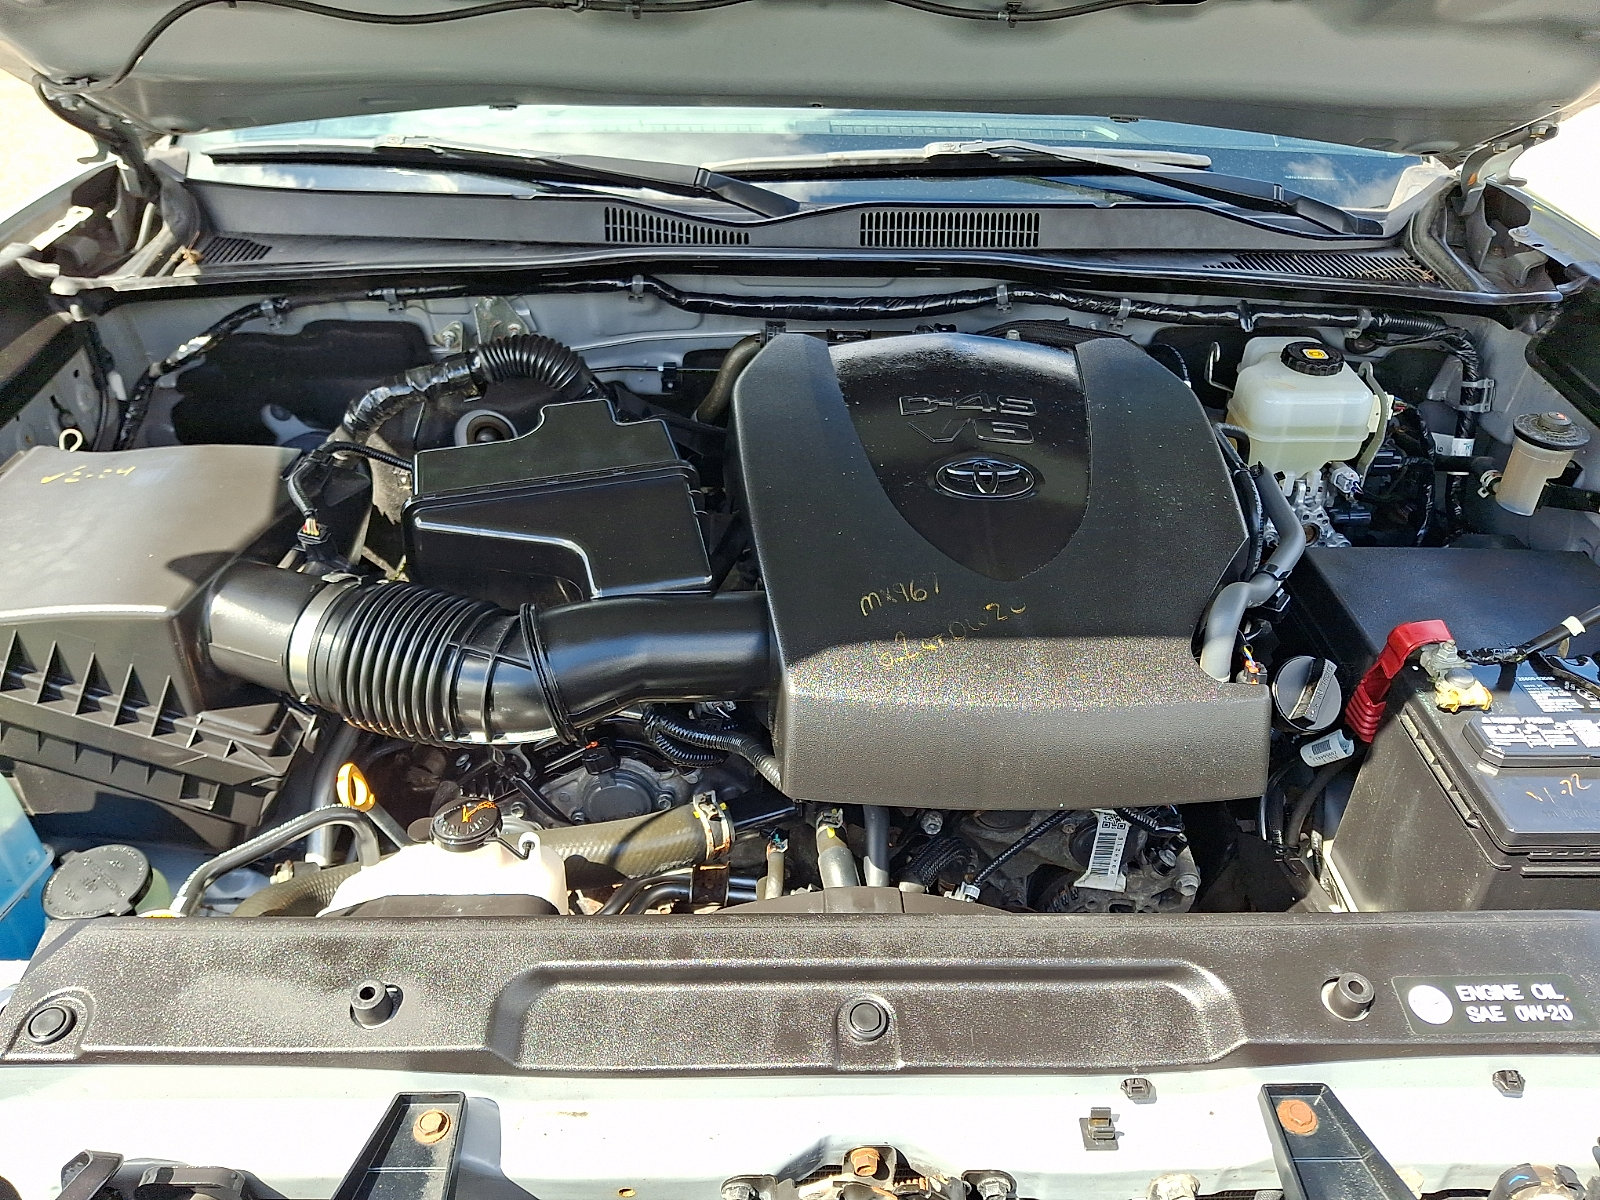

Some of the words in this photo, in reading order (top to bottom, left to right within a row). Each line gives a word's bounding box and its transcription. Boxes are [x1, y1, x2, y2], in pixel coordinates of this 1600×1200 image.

[899, 391, 1037, 416] D-4S
[906, 417, 1035, 444] V6
[1455, 984, 1524, 1002] ENGINE
[1530, 983, 1564, 1000] OIL
[1465, 1005, 1507, 1023] SAE
[1514, 1004, 1574, 1022] 0W-20
